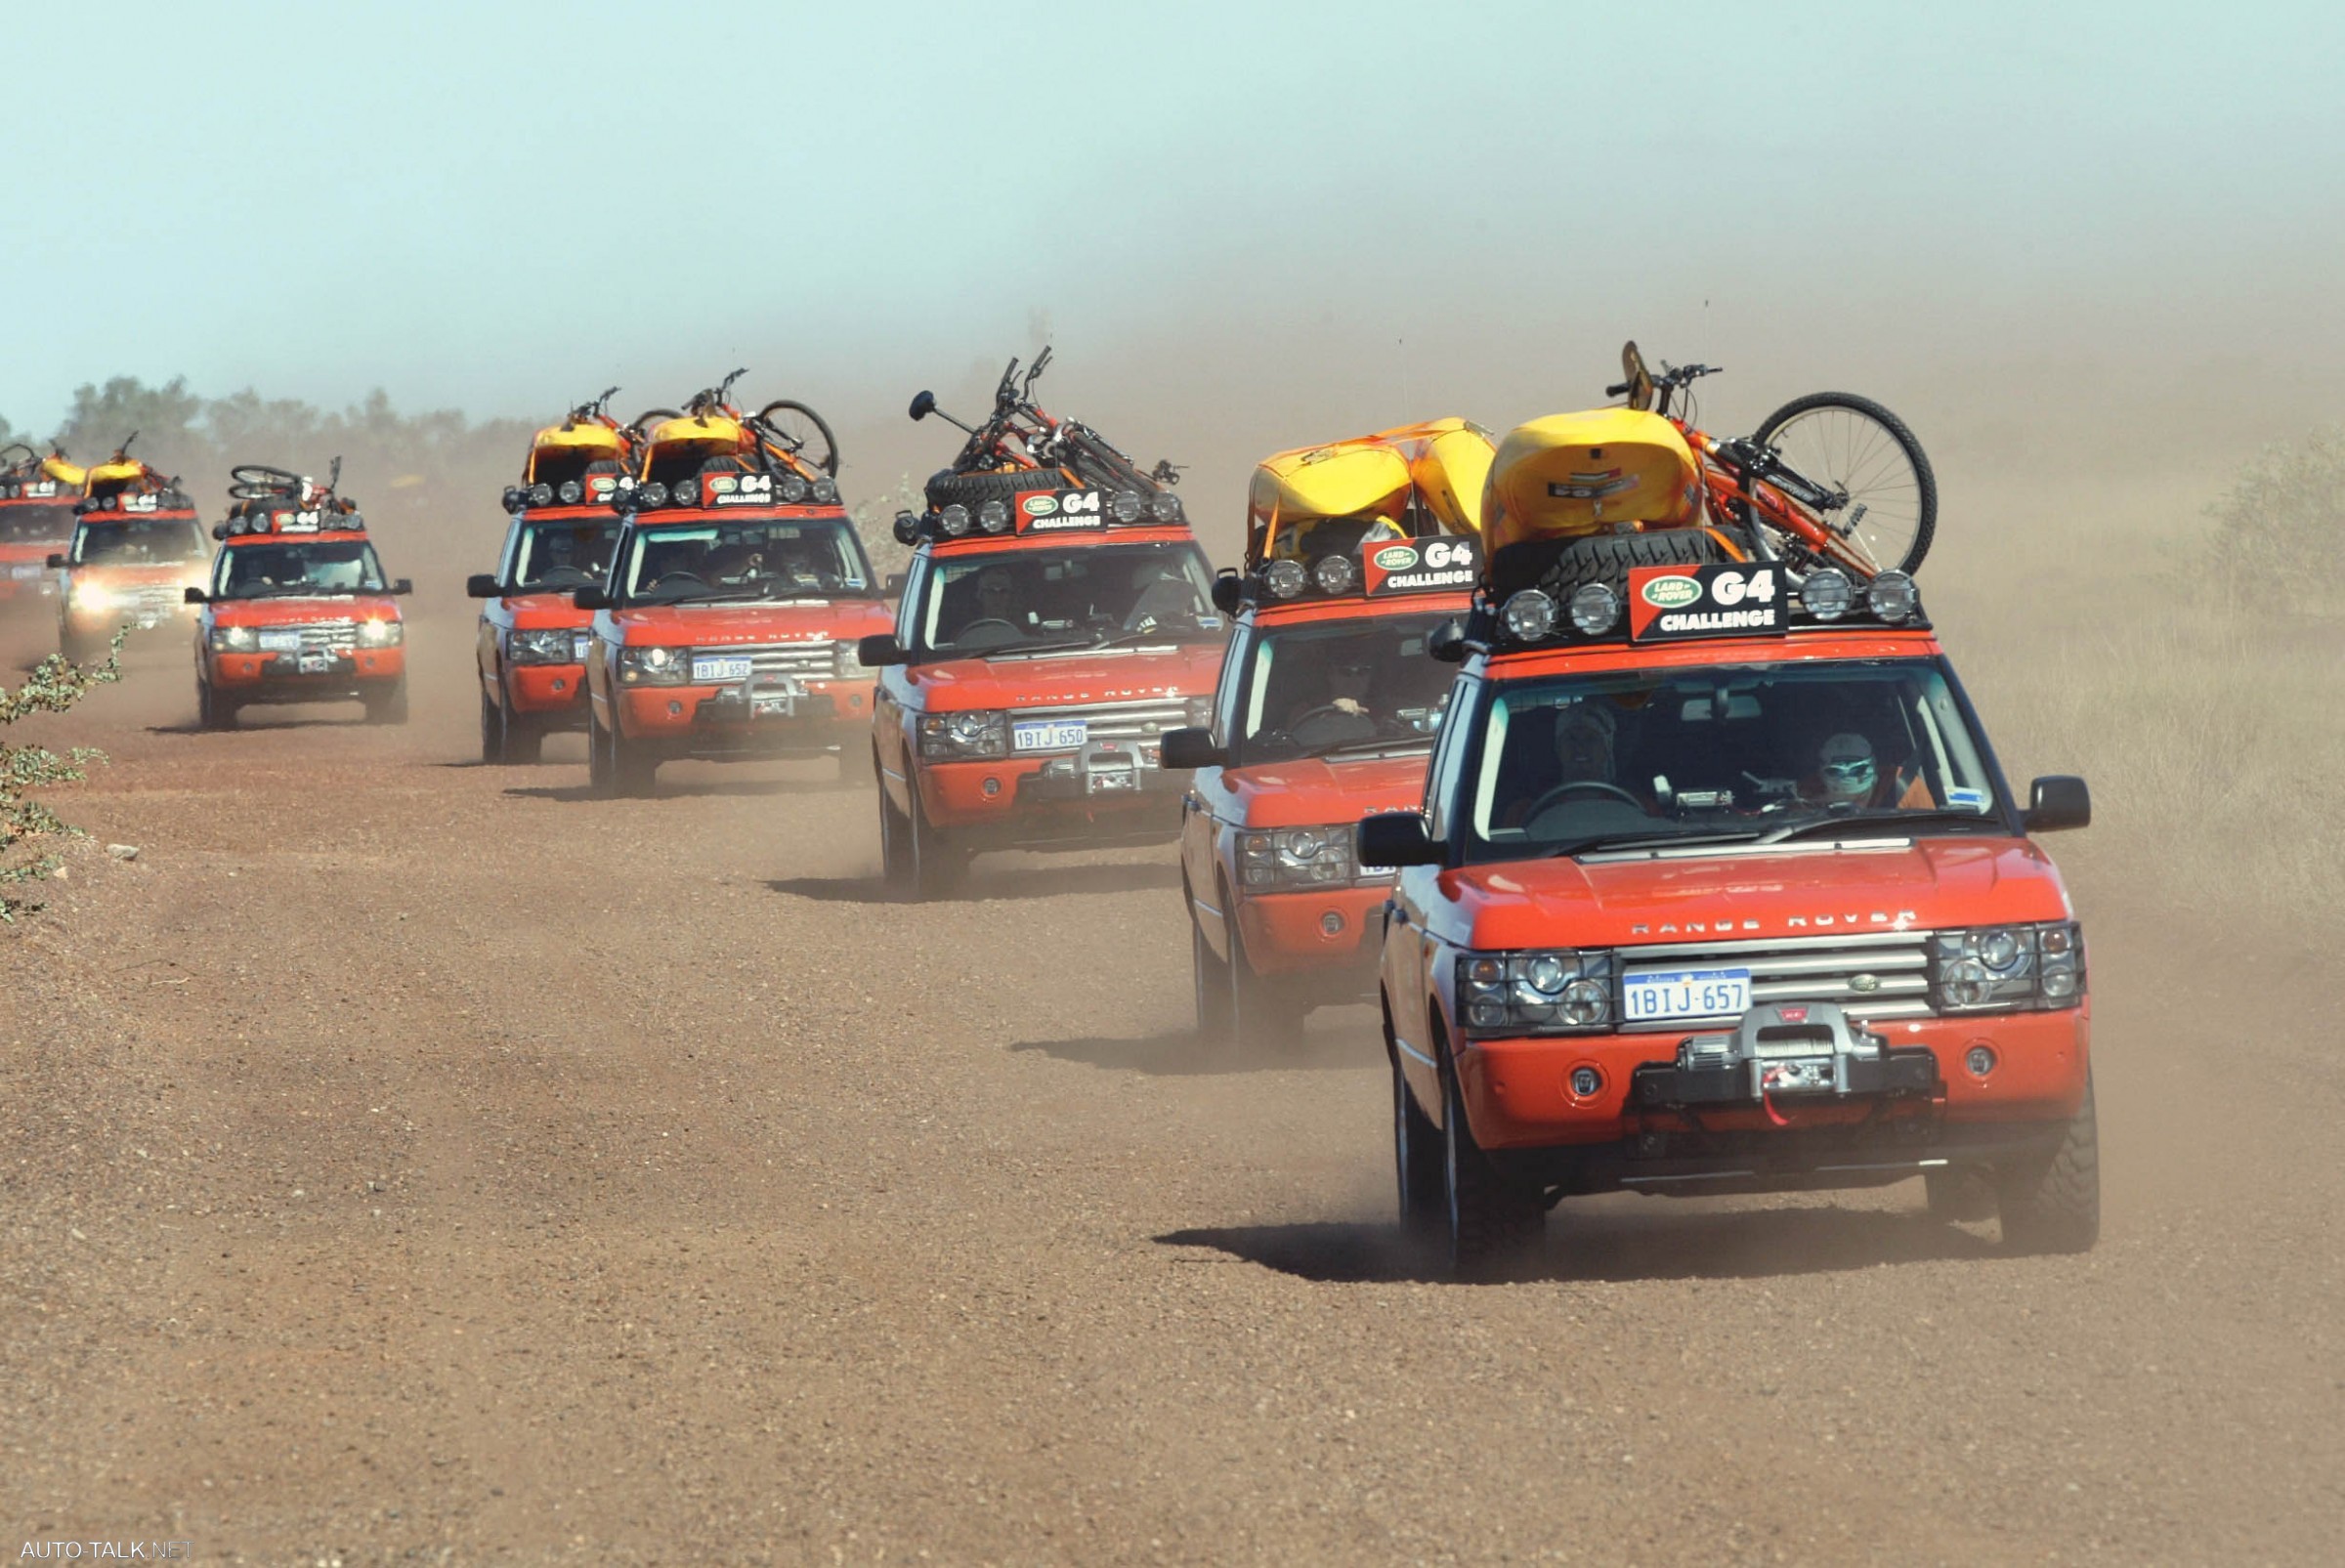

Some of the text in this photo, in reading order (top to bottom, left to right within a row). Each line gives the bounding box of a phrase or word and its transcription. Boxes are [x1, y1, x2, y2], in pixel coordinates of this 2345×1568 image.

[1063, 491, 1100, 513] G4
[1033, 516, 1101, 529] CHALLENGE
[1425, 541, 1472, 568] G4
[1387, 570, 1473, 588] CHALLENGE
[1712, 570, 1775, 606] G4
[1660, 609, 1775, 631] CHALLENGE
